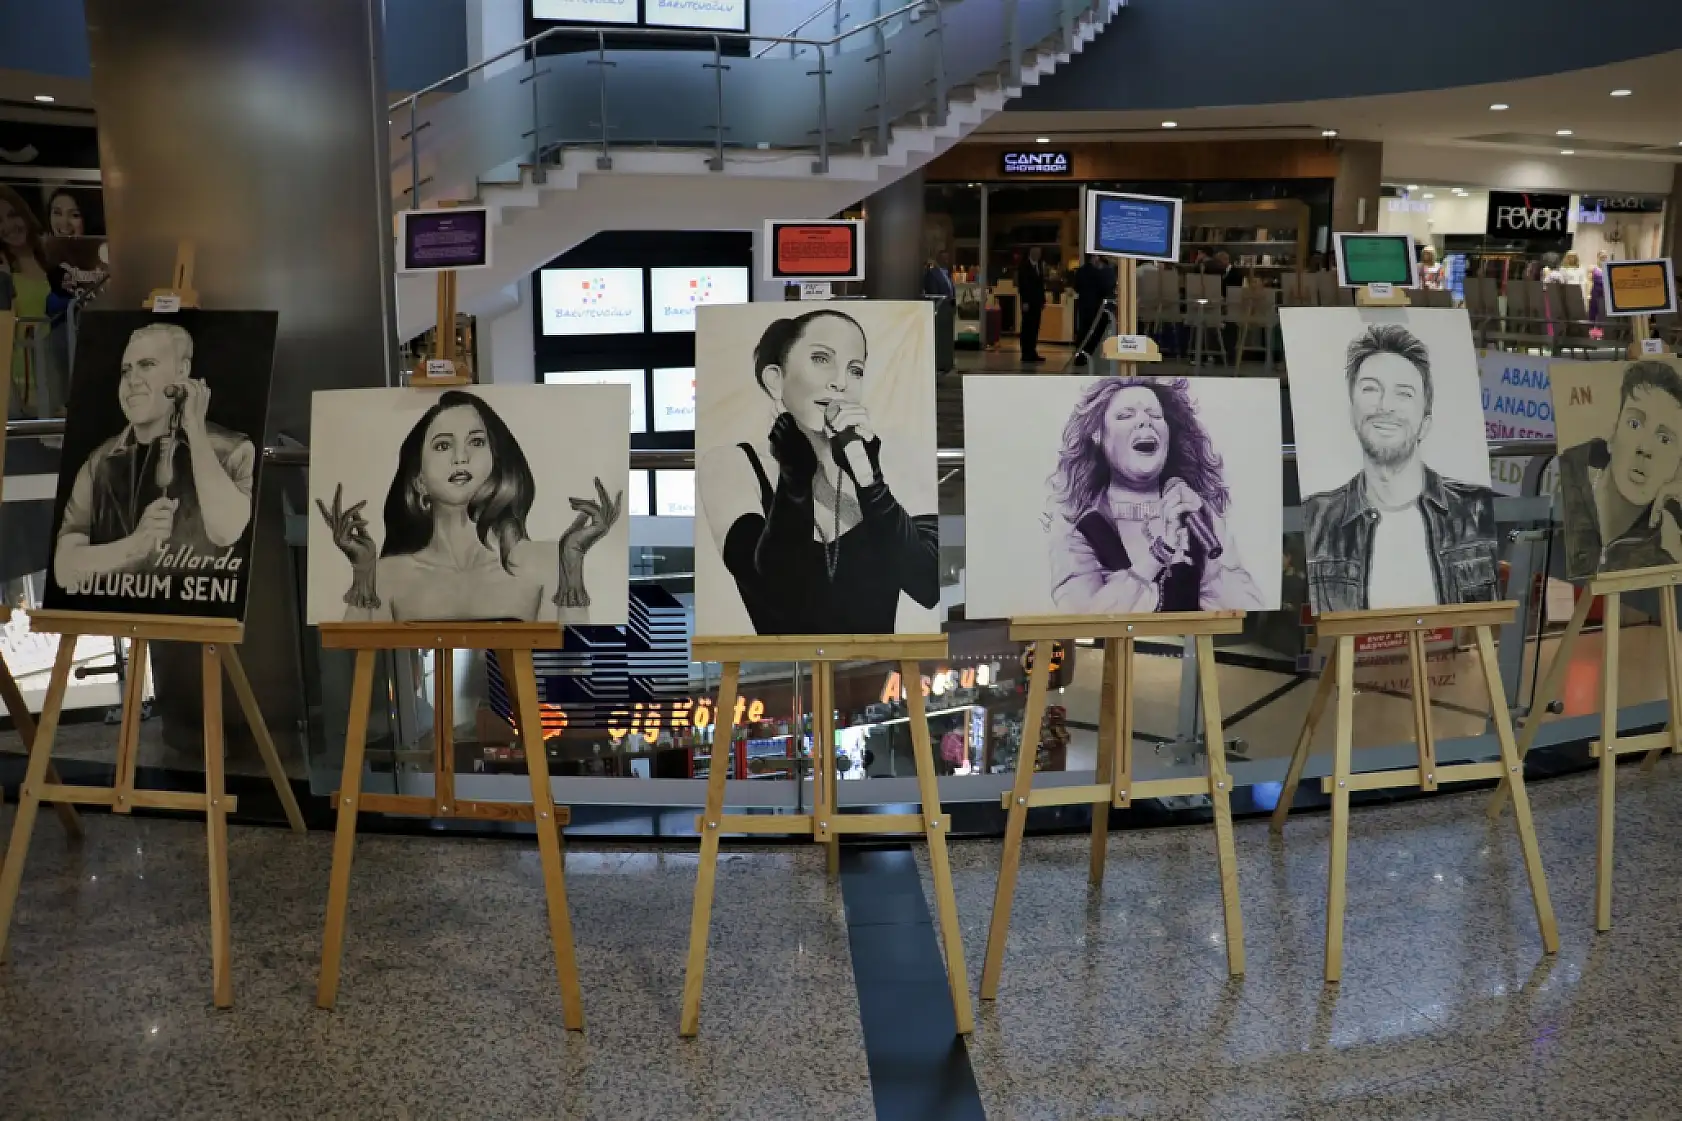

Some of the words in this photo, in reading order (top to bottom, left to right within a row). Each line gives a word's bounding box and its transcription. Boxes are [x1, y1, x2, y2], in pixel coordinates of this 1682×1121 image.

[1004, 164, 1067, 173] SHOWROOM
[1568, 385, 1593, 406] AN
[153, 538, 243, 571] Yollarda
[180, 574, 238, 604] SENİ
[671, 695, 765, 732] Köte
